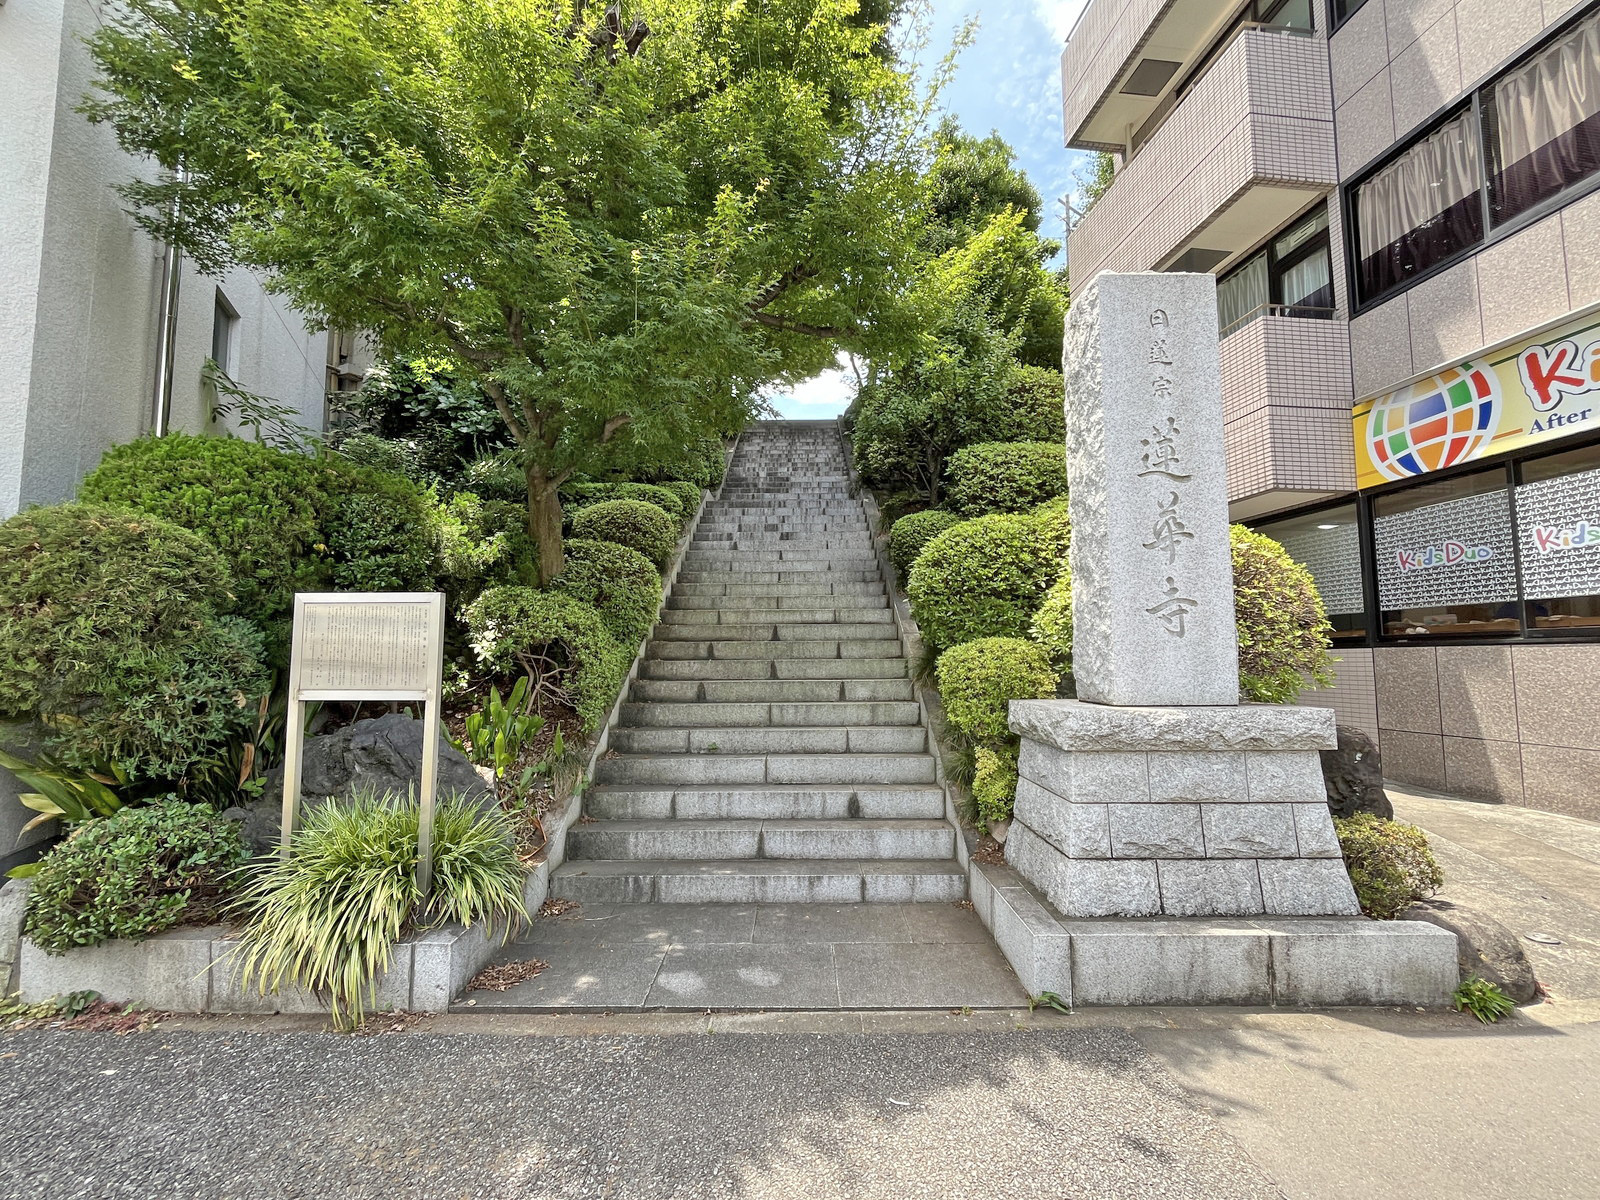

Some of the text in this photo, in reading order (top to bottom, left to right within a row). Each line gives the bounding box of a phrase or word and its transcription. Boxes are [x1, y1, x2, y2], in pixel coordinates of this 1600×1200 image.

[1528, 408, 1592, 435] After
[1137, 308, 1199, 639] 日蓮宗 蓮華寺
[1398, 542, 1490, 571] KidsDuo
